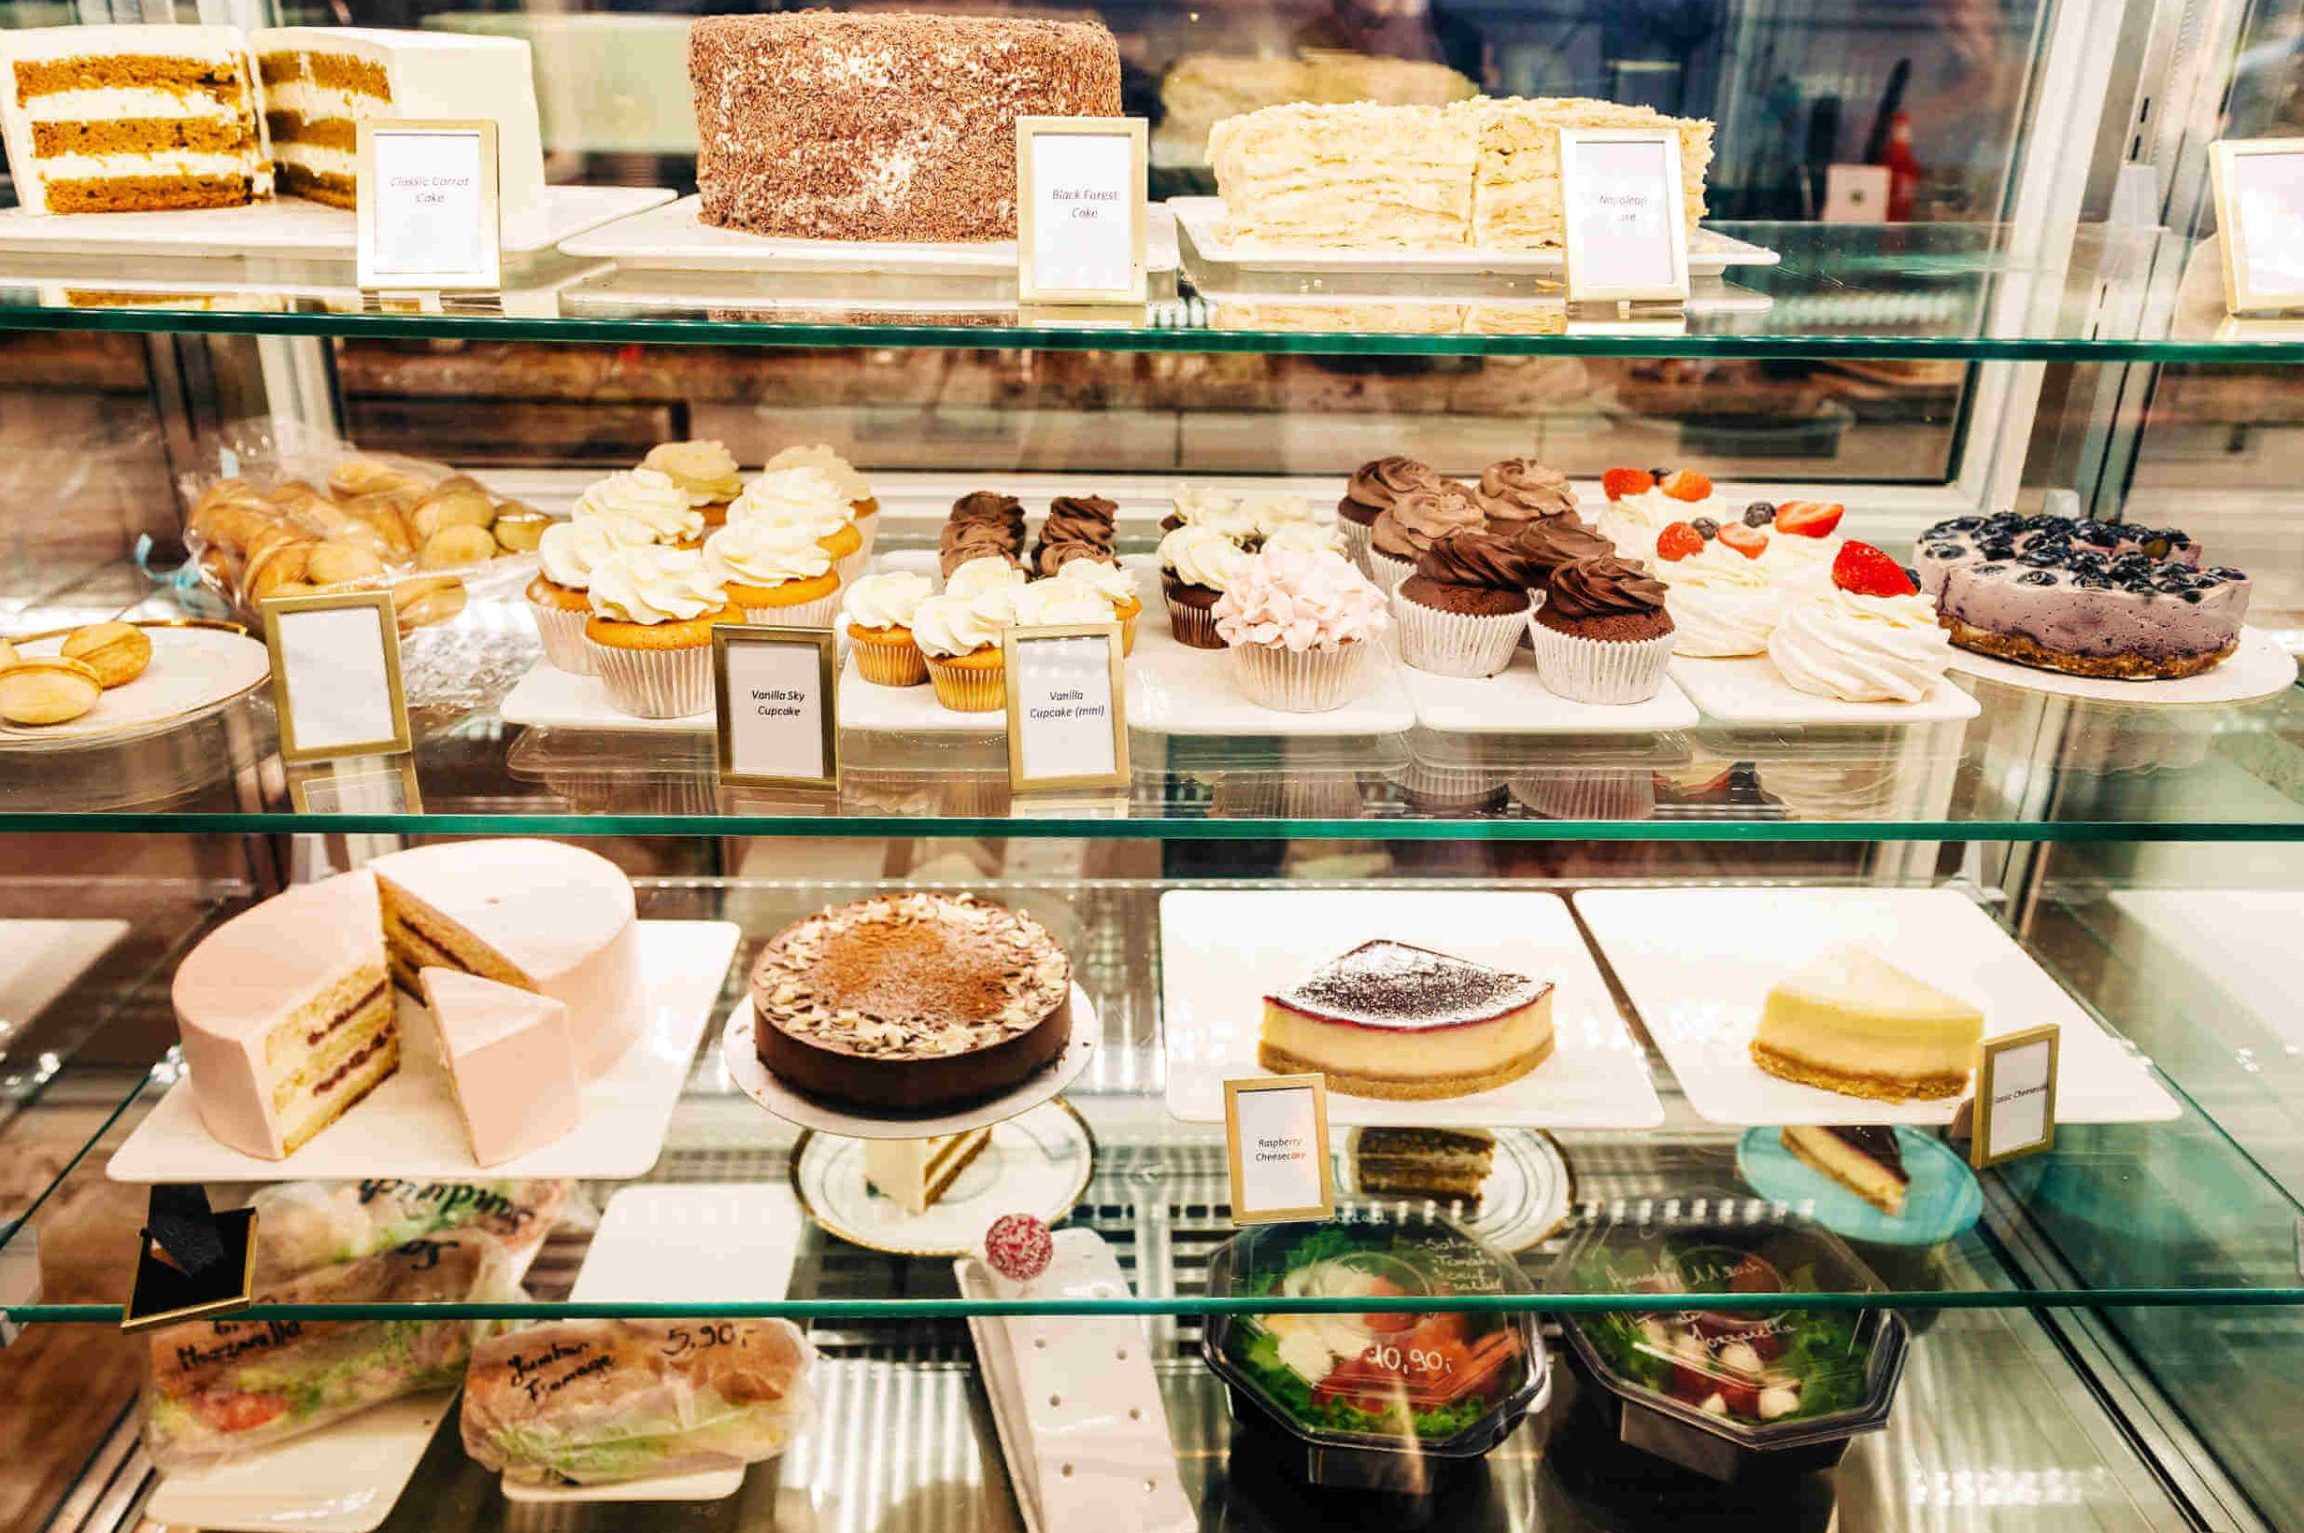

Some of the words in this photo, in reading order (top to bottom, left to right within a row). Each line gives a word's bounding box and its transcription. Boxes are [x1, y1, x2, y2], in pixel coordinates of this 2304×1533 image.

[431, 176, 469, 187] Carrot
[415, 192, 446, 204] Cake
[1052, 189, 1080, 200] Black
[1083, 189, 1120, 201] Forest
[1071, 206, 1098, 218] Cake
[751, 689, 785, 701] Vanilla
[787, 689, 805, 703] Sky
[1049, 689, 1084, 701] Vanilla
[757, 705, 802, 717] Cupcake
[1029, 707, 1073, 719] Cupcake
[1258, 1138, 1302, 1149] Raspberry
